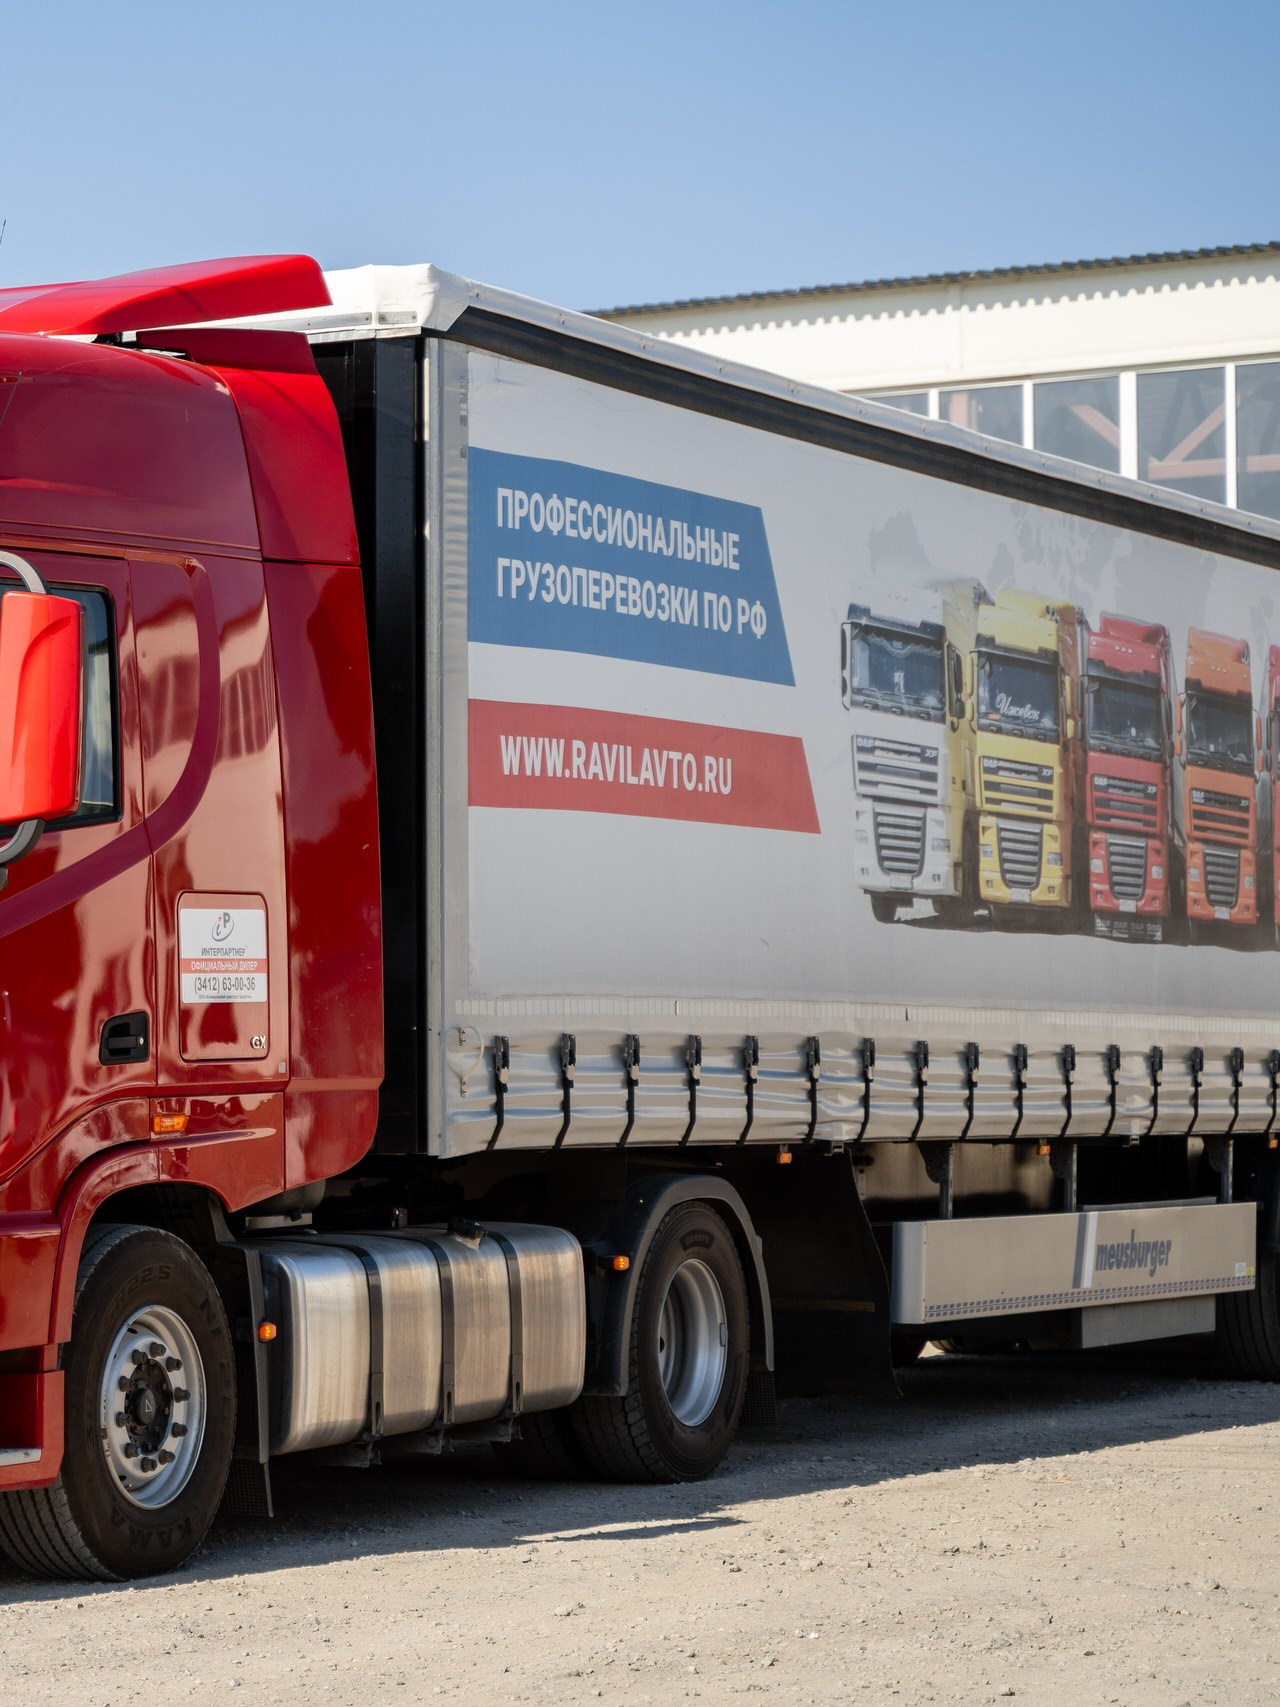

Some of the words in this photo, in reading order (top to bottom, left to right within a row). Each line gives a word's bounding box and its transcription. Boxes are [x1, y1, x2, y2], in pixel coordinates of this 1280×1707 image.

[496, 487, 740, 570] ПРОФЕССИОНАЛЬНЫЕ
[496, 557, 698, 626] ГРУЗОПЕРЕВОЗКИ
[704, 592, 732, 632] ПО
[737, 598, 767, 639] РФ
[499, 734, 732, 795] WWW.RAVILAVTO.RU
[923, 748, 938, 759] XF
[191, 960, 238, 972] ОФИЦИАЛЬНЫЙ
[201, 947, 246, 957] ИНТЕРПАРТНЕР
[194, 976, 220, 995] (3412)
[222, 976, 256, 991] 63-00-36
[1095, 1228, 1172, 1277] meusburger
